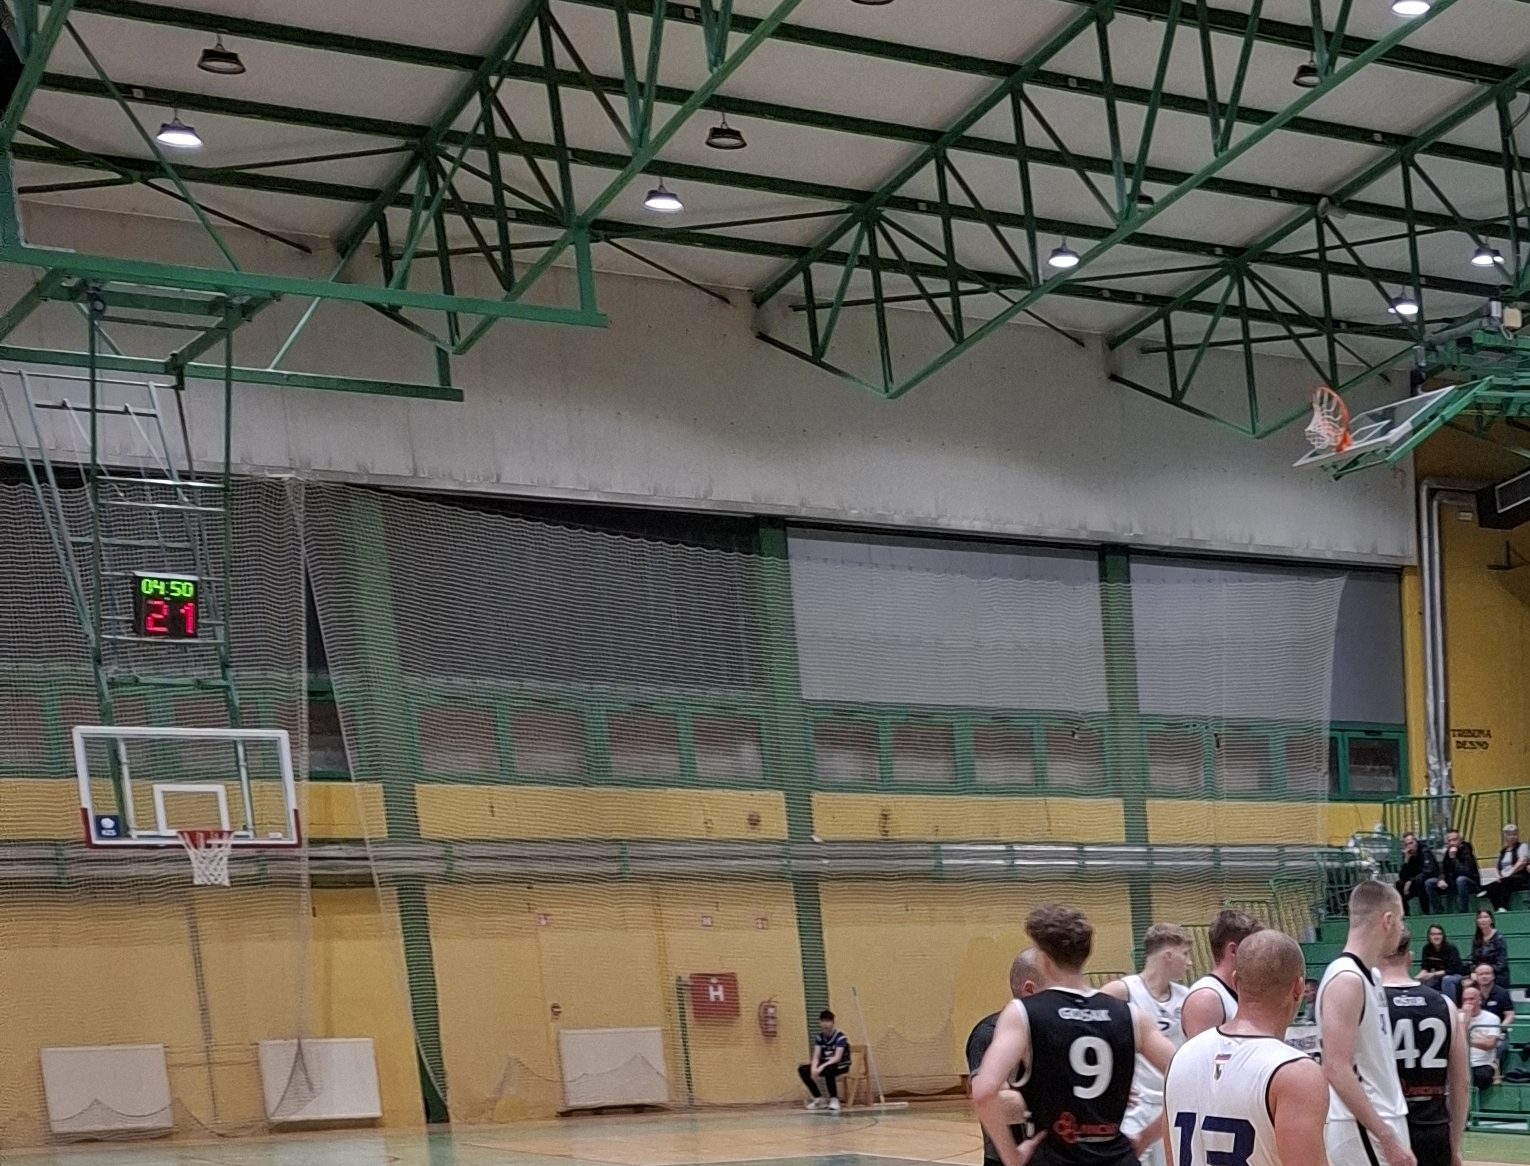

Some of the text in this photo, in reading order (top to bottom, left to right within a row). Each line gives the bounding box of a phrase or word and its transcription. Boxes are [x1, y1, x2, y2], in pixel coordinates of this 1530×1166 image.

[141, 579, 194, 597] 04:50
[146, 601, 195, 634] 21
[708, 984, 725, 1002] H
[1393, 1018, 1448, 1068] 42
[1068, 1036, 1114, 1099] 9
